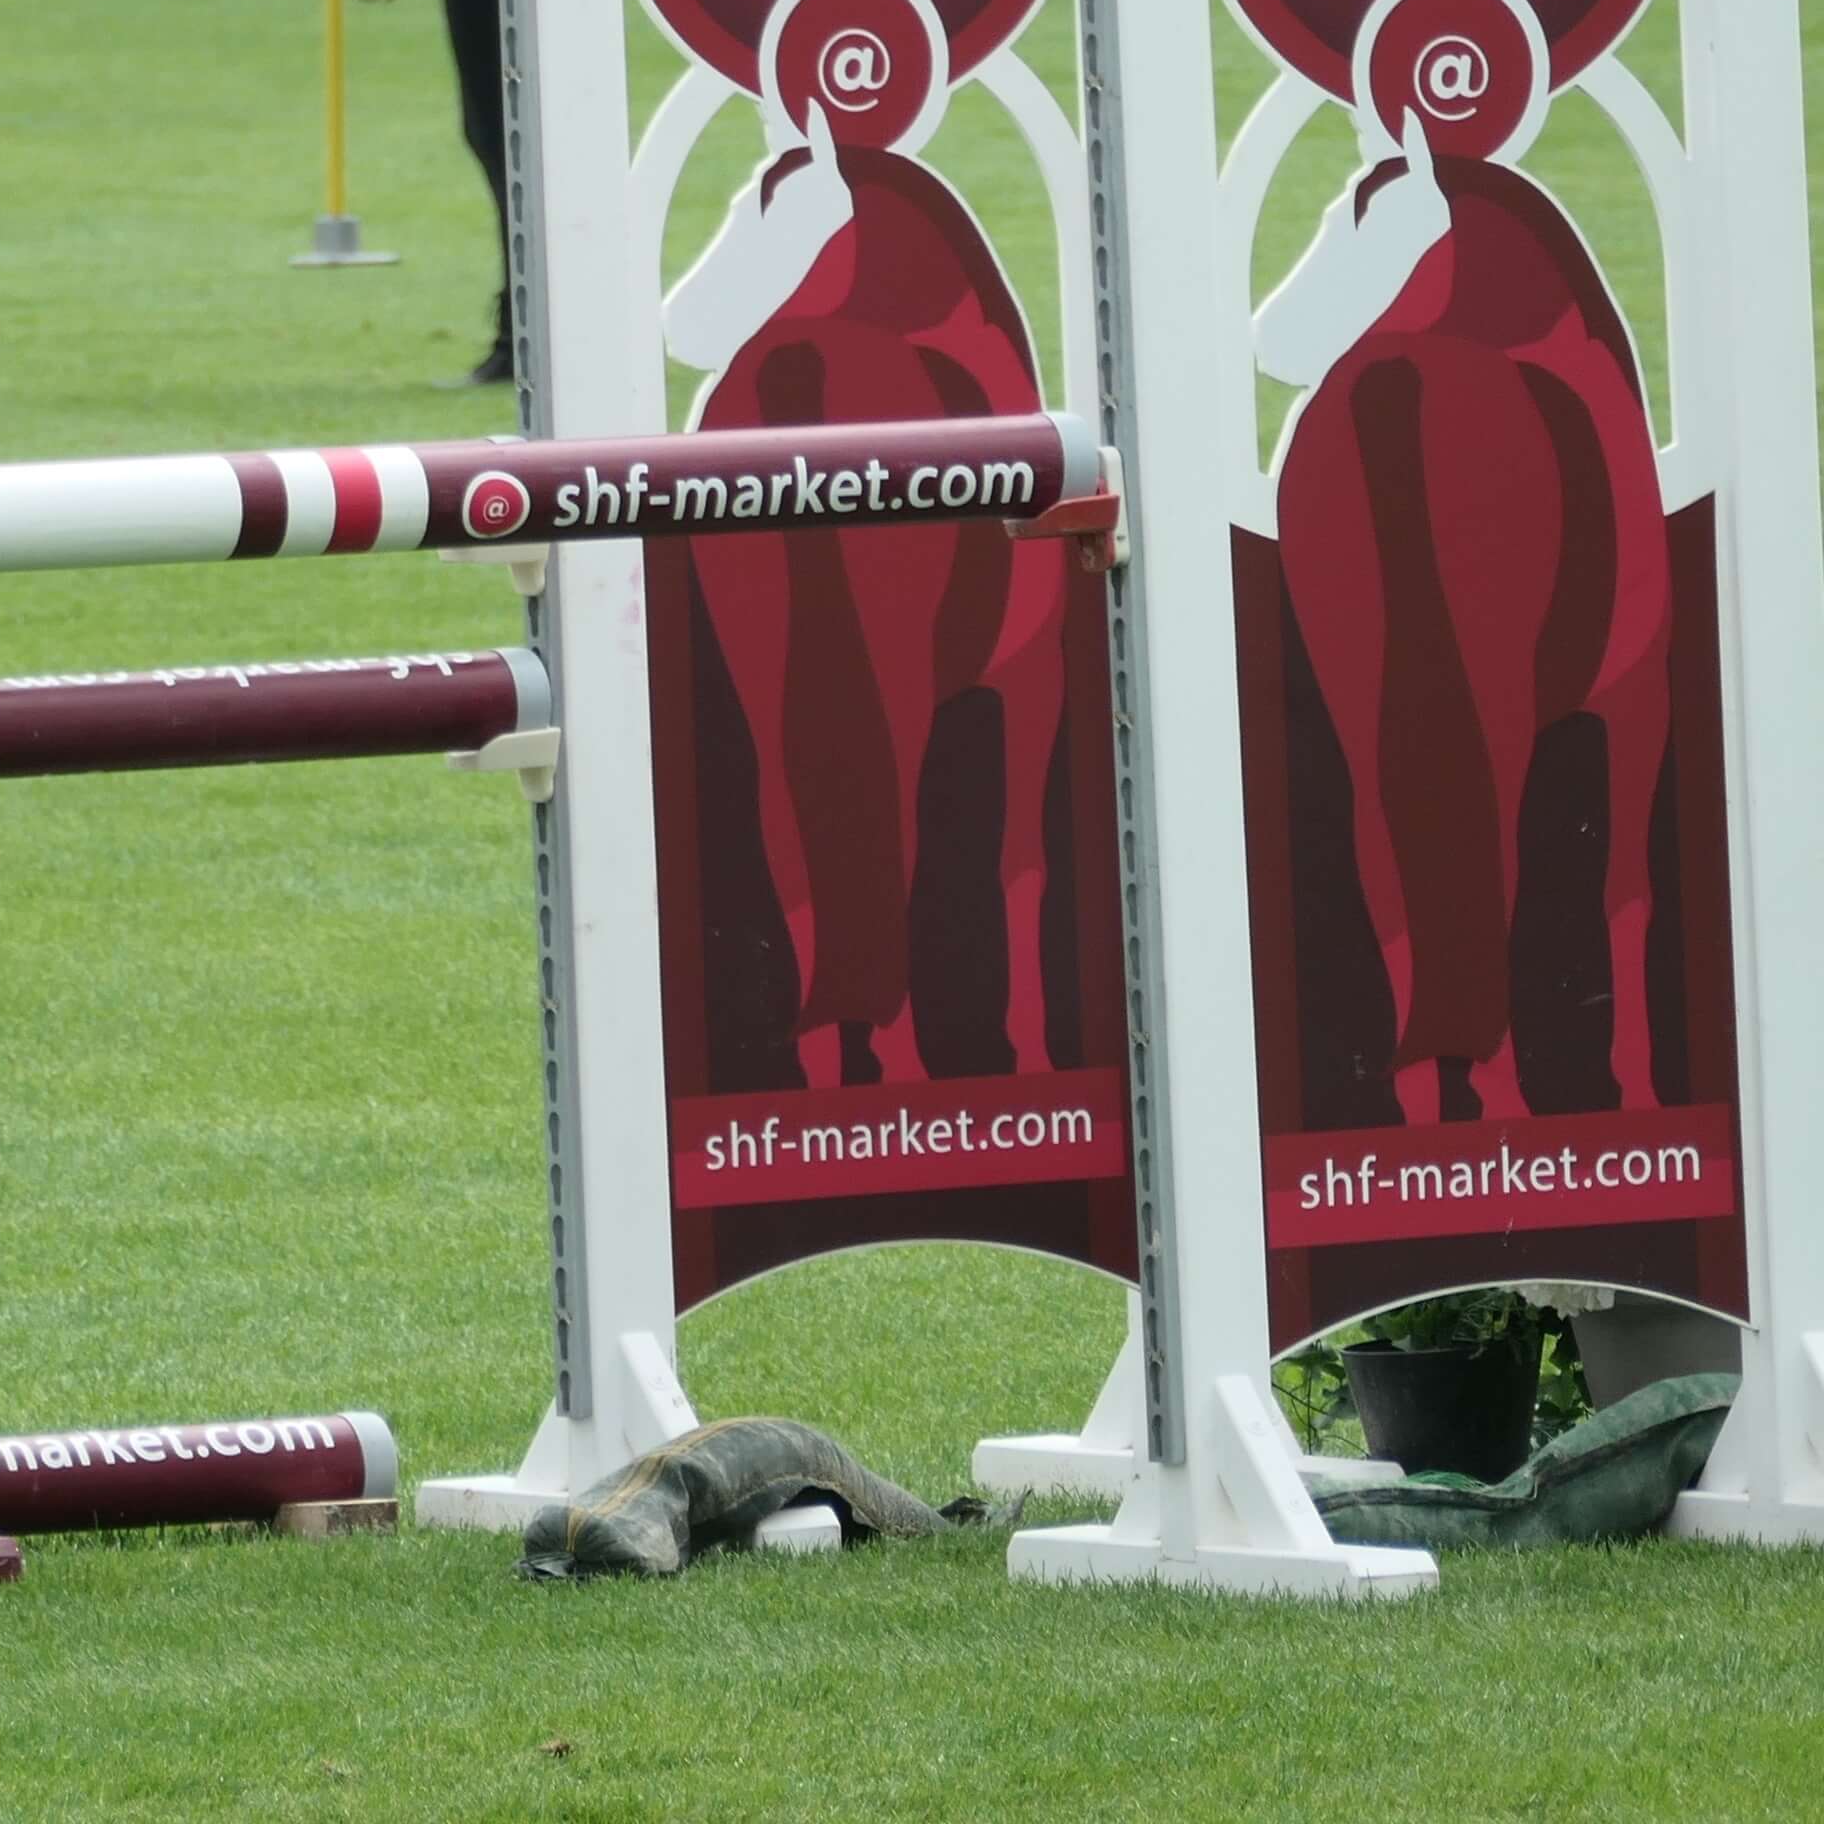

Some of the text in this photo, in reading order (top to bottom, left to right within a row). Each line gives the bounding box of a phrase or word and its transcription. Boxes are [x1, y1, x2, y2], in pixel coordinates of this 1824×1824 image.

[817, 28, 891, 113] @
[1412, 34, 1489, 121] @
[552, 456, 1035, 528] shf-market.com
[704, 1106, 1093, 1172] shf-market.com
[1299, 1141, 1702, 1210] shf-market.com
